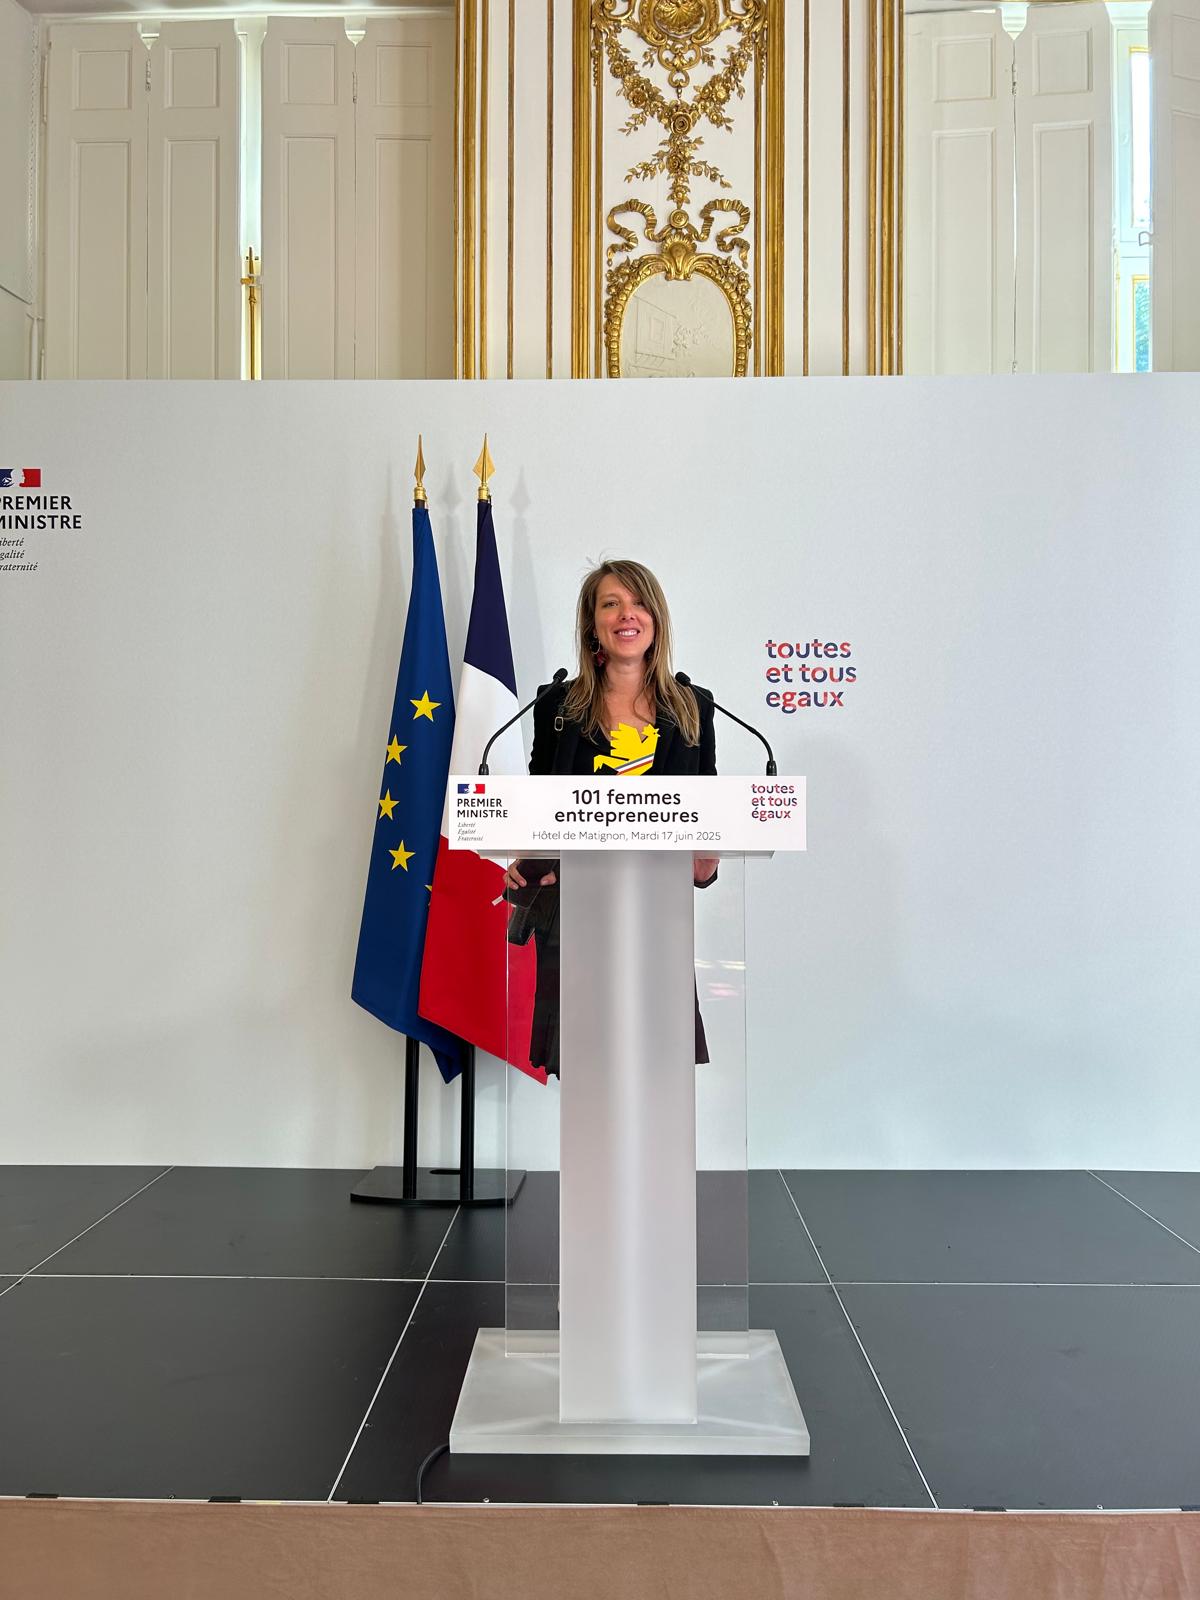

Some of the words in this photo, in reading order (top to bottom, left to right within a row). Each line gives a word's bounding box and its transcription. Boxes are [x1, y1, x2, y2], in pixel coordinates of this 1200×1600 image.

[0, 496, 72, 510] REMIER
[0, 550, 25, 560] galité
[765, 639, 851, 659] toutes
[766, 664, 793, 683] et
[799, 664, 857, 683] tous
[766, 691, 844, 714] egaux
[751, 784, 795, 794] toutes
[457, 798, 503, 807] PREMIER
[572, 789, 600, 805] 101
[606, 788, 681, 805] femmes
[751, 796, 766, 807] et
[767, 796, 798, 807] tous
[457, 809, 509, 818] MINISTRE
[554, 808, 699, 827] entrepreneures
[751, 807, 791, 822] égaux
[532, 830, 561, 840] Hôtel
[562, 831, 577, 840] de
[579, 831, 629, 842] Matignon,
[631, 831, 660, 840] Mardi
[661, 831, 673, 840] 17
[673, 831, 694, 843] juin
[696, 831, 721, 841] 2025
